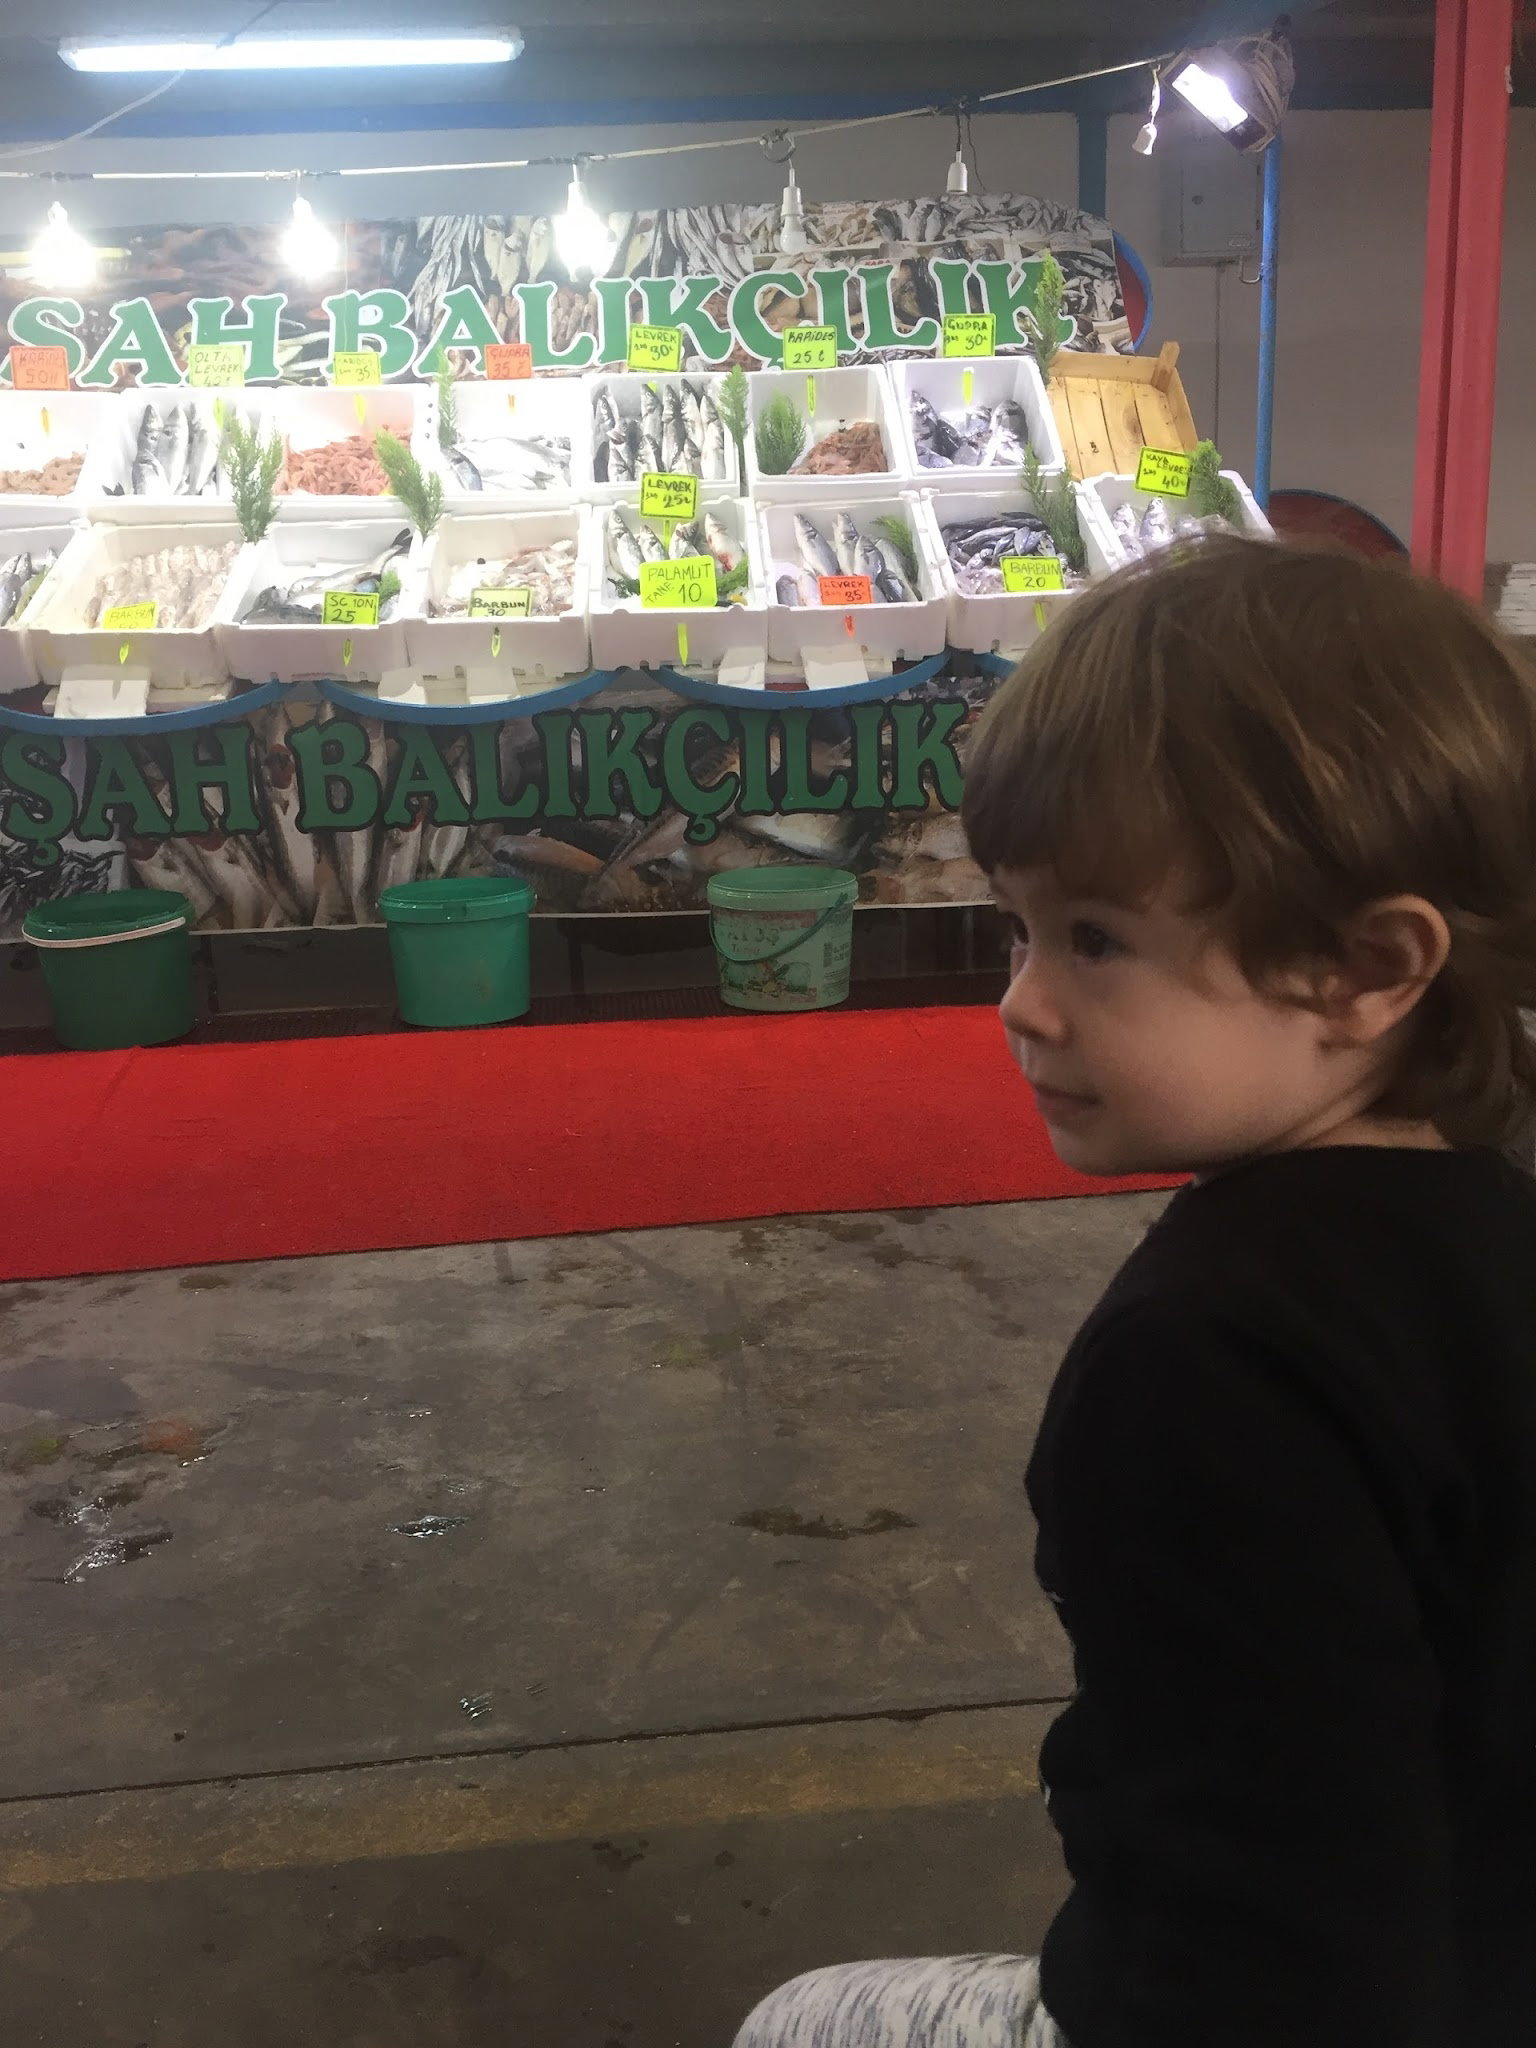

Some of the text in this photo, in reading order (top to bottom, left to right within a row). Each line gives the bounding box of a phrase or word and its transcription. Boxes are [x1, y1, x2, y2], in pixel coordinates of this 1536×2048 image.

[635, 330, 677, 343] LEVREK
[792, 350, 812, 364] 25
[648, 479, 692, 493] LEVREK
[648, 563, 711, 581] PALAMUT
[1010, 561, 1060, 575] BARBUN
[1023, 576, 1046, 588] 20
[678, 582, 702, 604] 10
[471, 597, 526, 608] BARBUN
[331, 608, 357, 623] 25
[2, 700, 970, 868] ŞAH BALIKÇILIK
